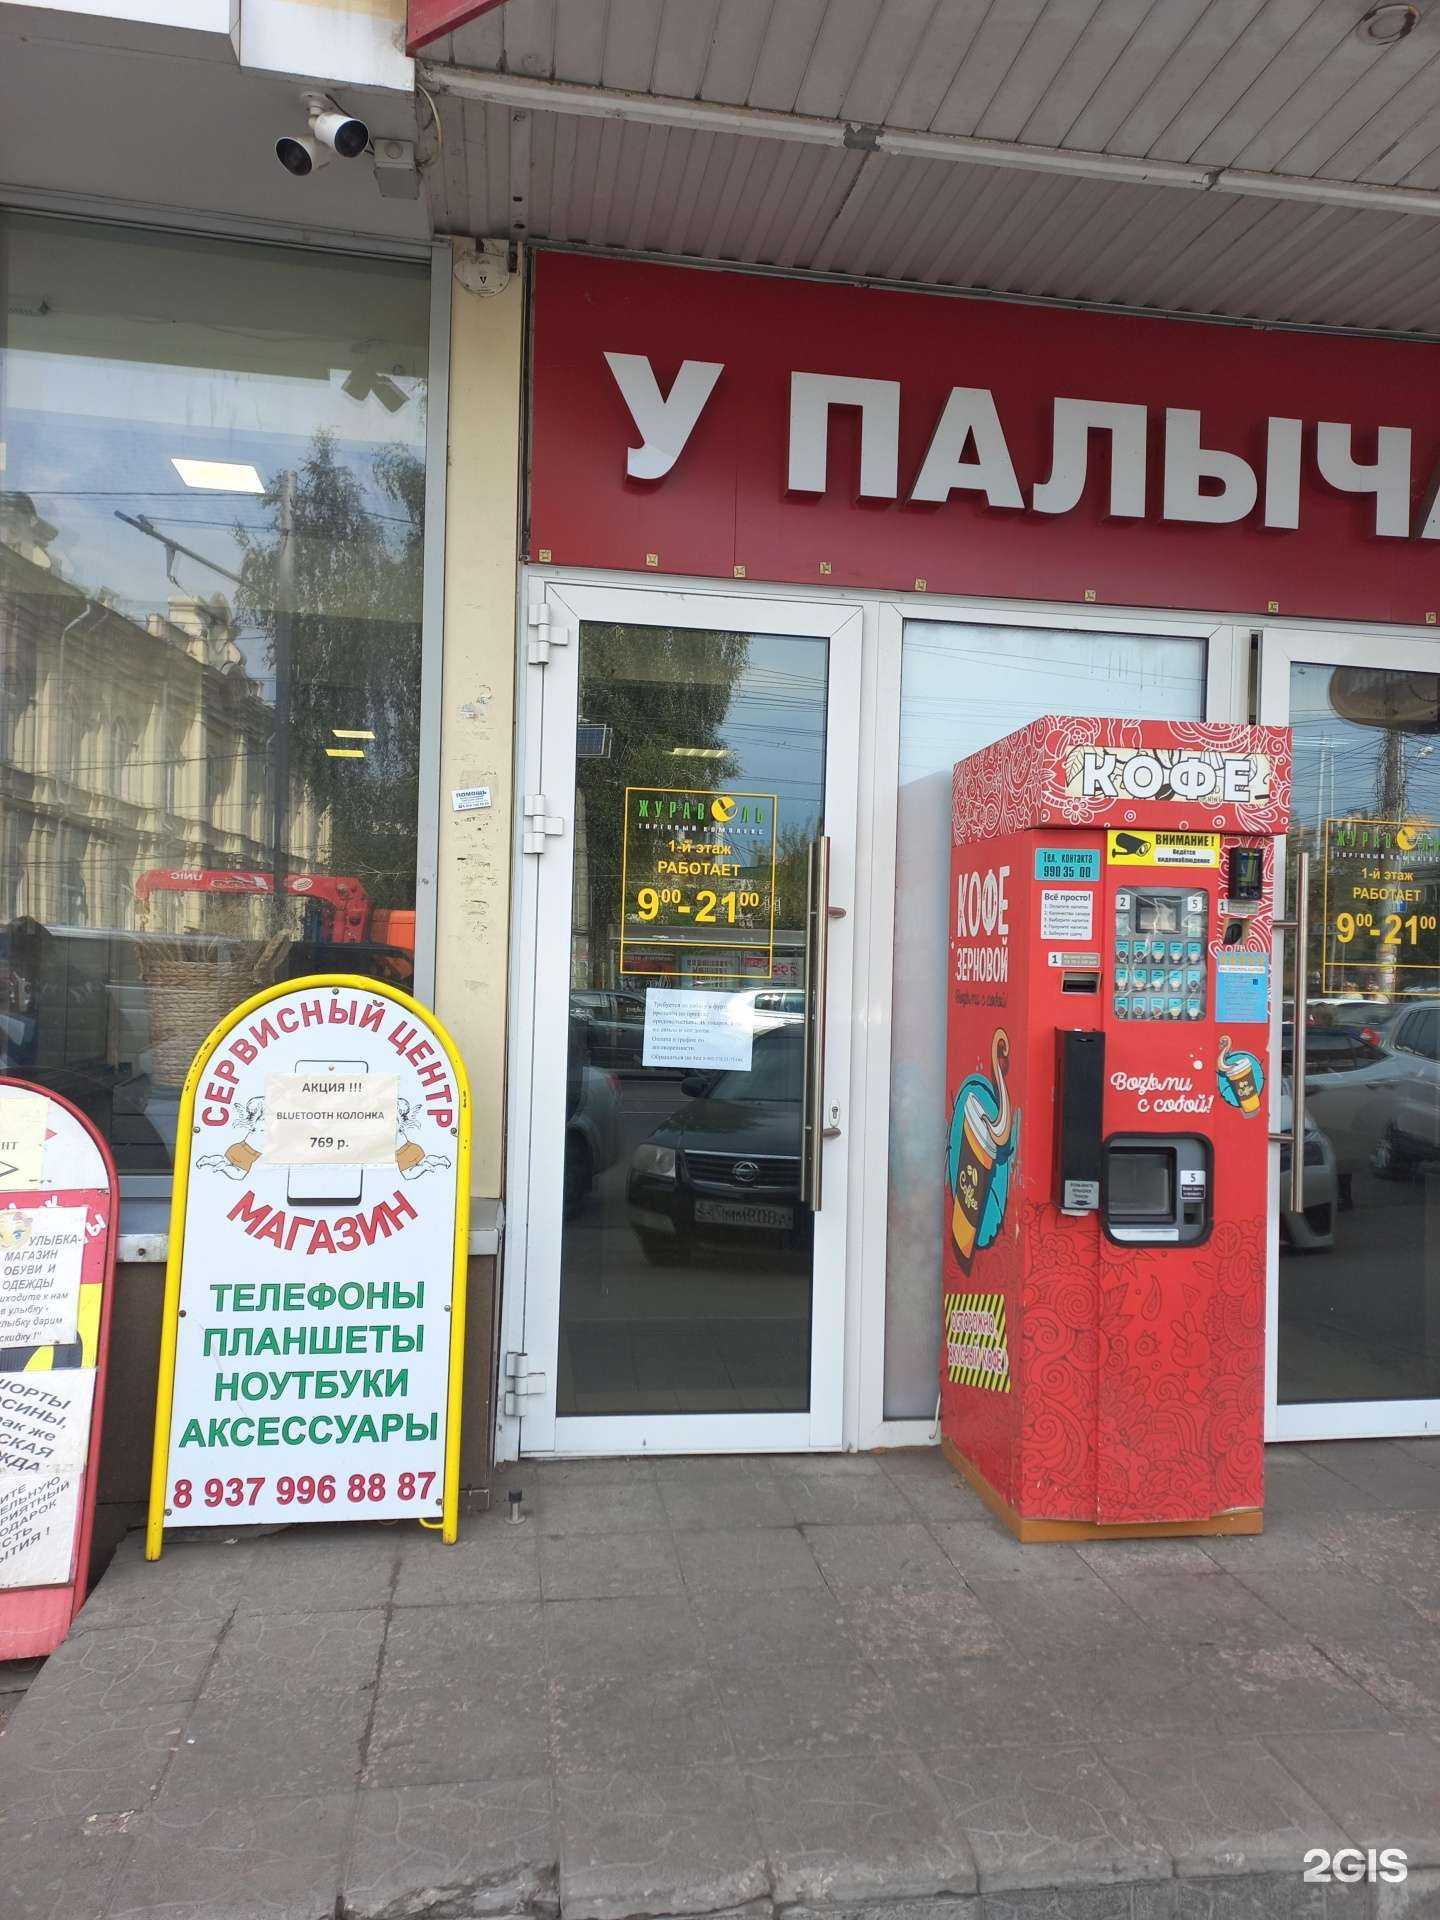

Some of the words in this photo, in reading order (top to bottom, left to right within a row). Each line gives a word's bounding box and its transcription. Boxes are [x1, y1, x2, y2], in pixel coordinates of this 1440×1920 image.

[602, 351, 725, 480] У
[787, 370, 1440, 540] ПАЛЫЧ
[1083, 752, 1250, 803] КОФЕ
[668, 839, 691, 854] 1-й
[696, 843, 732, 855] этаж
[1155, 834, 1209, 846] ВНИМАНИЕ
[1043, 851, 1058, 863] Тел.
[1061, 854, 1093, 864] контакта
[657, 860, 741, 877] РАБОТАЕТ
[1043, 865, 1061, 878] 990
[1063, 866, 1075, 878] 35
[1079, 866, 1091, 878] 00
[1361, 867, 1380, 880] 1-й
[1384, 870, 1414, 881] этаж
[957, 865, 1010, 937] КОФЕ
[1061, 893, 1091, 904] просто!
[1352, 887, 1422, 902] РАБОТАЕТ
[1120, 897, 1126, 907] 2
[1192, 899, 1198, 909] 5
[1220, 901, 1225, 911] 1
[956, 936, 1009, 983] ЗЕРНОВОЙ
[1052, 954, 1058, 964] 1
[202, 998, 386, 1127] СЕРВИСНЫЙ
[388, 1020, 453, 1128] ЦЕНТР
[302, 1083, 345, 1094] АКЦИЯ
[1110, 1072, 1193, 1095] Возьми
[1137, 1099, 1150, 1113] с
[1153, 1094, 1214, 1113] собой!
[276, 1112, 333, 1120] BLUETOOTH
[336, 1112, 385, 1120] КОЛОНКА
[310, 1137, 333, 1148] 769
[337, 1139, 349, 1150] р.
[1191, 1173, 1196, 1183] 5
[226, 1189, 419, 1255] МАГАЗИН
[4, 1250, 59, 1262] МАГАЗИН
[3, 1264, 43, 1276] ОБУВИ
[47, 1264, 56, 1274] И
[2, 1278, 54, 1292] ОДЕЖДЫ
[51, 1292, 69, 1301] нам
[209, 1281, 425, 1312] ТЕЛЕФОНЫ
[33, 1317, 63, 1327] дарим
[203, 1325, 424, 1357] ПЛАНШЕТЫ
[214, 1368, 409, 1401] НОУТБУКИ
[28, 1427, 56, 1442] же
[178, 1412, 438, 1448] АКСЕССУАРЫ
[172, 1479, 192, 1509] 8
[204, 1477, 266, 1508] 937
[276, 1475, 336, 1504] 996
[347, 1473, 386, 1503] 88
[397, 1471, 437, 1501] 87
